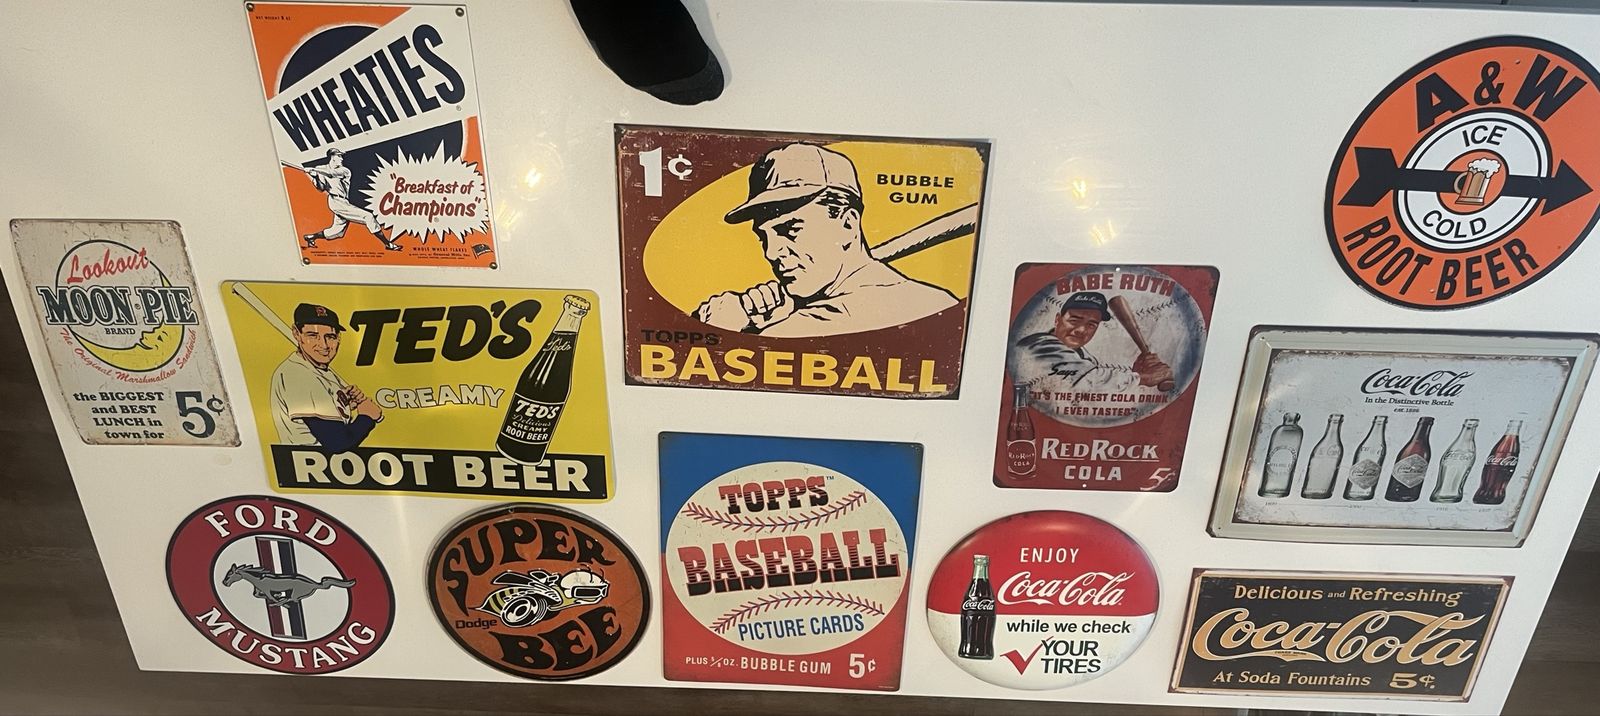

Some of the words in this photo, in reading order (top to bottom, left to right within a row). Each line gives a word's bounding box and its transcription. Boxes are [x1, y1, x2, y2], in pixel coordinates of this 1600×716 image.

[273, 24, 465, 152] WHEATIES
[1462, 125, 1507, 147] ICE
[460, 182, 474, 194] of
[876, 173, 954, 189] BUBBLE
[889, 192, 938, 205] GUM
[1423, 210, 1486, 238] COLD
[67, 248, 150, 284] Lookout
[1343, 216, 1432, 295] ROOT
[1436, 238, 1540, 300] BEER
[1056, 273, 1114, 295] BABE
[1120, 274, 1176, 297] RUTH
[37, 286, 136, 326] MOON
[136, 286, 199, 326] PIE
[350, 299, 542, 366] TED'S
[640, 330, 720, 346] TOPPS
[60, 328, 73, 346] The
[74, 348, 113, 376] Original
[115, 368, 176, 384] Marshmallow
[176, 328, 196, 369] Sandwich
[640, 344, 948, 393] BASEBALL
[1048, 361, 1078, 380] Says
[1361, 368, 1475, 396] Coca-Cola
[73, 392, 97, 401] the
[98, 392, 164, 401] BIGGEST
[375, 384, 505, 410] CREAMY
[1055, 392, 1072, 400] THE
[1075, 393, 1108, 402] FINEST
[1110, 394, 1135, 402] COLA
[1138, 394, 1168, 403] DRINK
[92, 405, 118, 414] and
[119, 405, 157, 414] BEST
[515, 400, 560, 419] TED'S
[1056, 406, 1060, 414] I
[1063, 406, 1089, 415] EVER
[93, 418, 146, 426] LUNCH
[147, 418, 163, 426] in
[512, 421, 548, 432] CREAMY
[104, 430, 141, 439] town
[144, 430, 165, 439] for
[506, 426, 526, 438] ROOT
[526, 432, 548, 440] BEER
[291, 450, 435, 487] ROOT
[453, 455, 591, 492] BEER
[1064, 466, 1122, 481] COLA
[719, 476, 830, 514] TOPPS
[205, 504, 337, 546] FORD
[678, 528, 901, 596] BASEBALL
[1020, 548, 1079, 563] ENJOY
[443, 518, 616, 616] SUPER
[1234, 585, 1323, 600] Delicious
[1328, 590, 1345, 598] and
[1349, 586, 1463, 607] Refreshing
[455, 618, 497, 630] Dodge
[738, 618, 806, 641] PICTURE
[810, 613, 865, 636] CARDS
[1007, 619, 1049, 633] while
[1055, 623, 1077, 633] we
[1082, 620, 1131, 634] check
[196, 607, 376, 668] MUSTANG
[489, 606, 622, 671] BEE
[1193, 608, 1486, 667] Coca-Cola
[1041, 640, 1098, 656] YOUR
[686, 657, 708, 665] PLUS
[740, 656, 795, 672] BUBBLE
[800, 661, 831, 674] GUM
[1041, 658, 1101, 674] TIRES
[1213, 671, 1233, 684] At
[1238, 671, 1280, 684] Soda
[1288, 672, 1371, 686] Fountains
